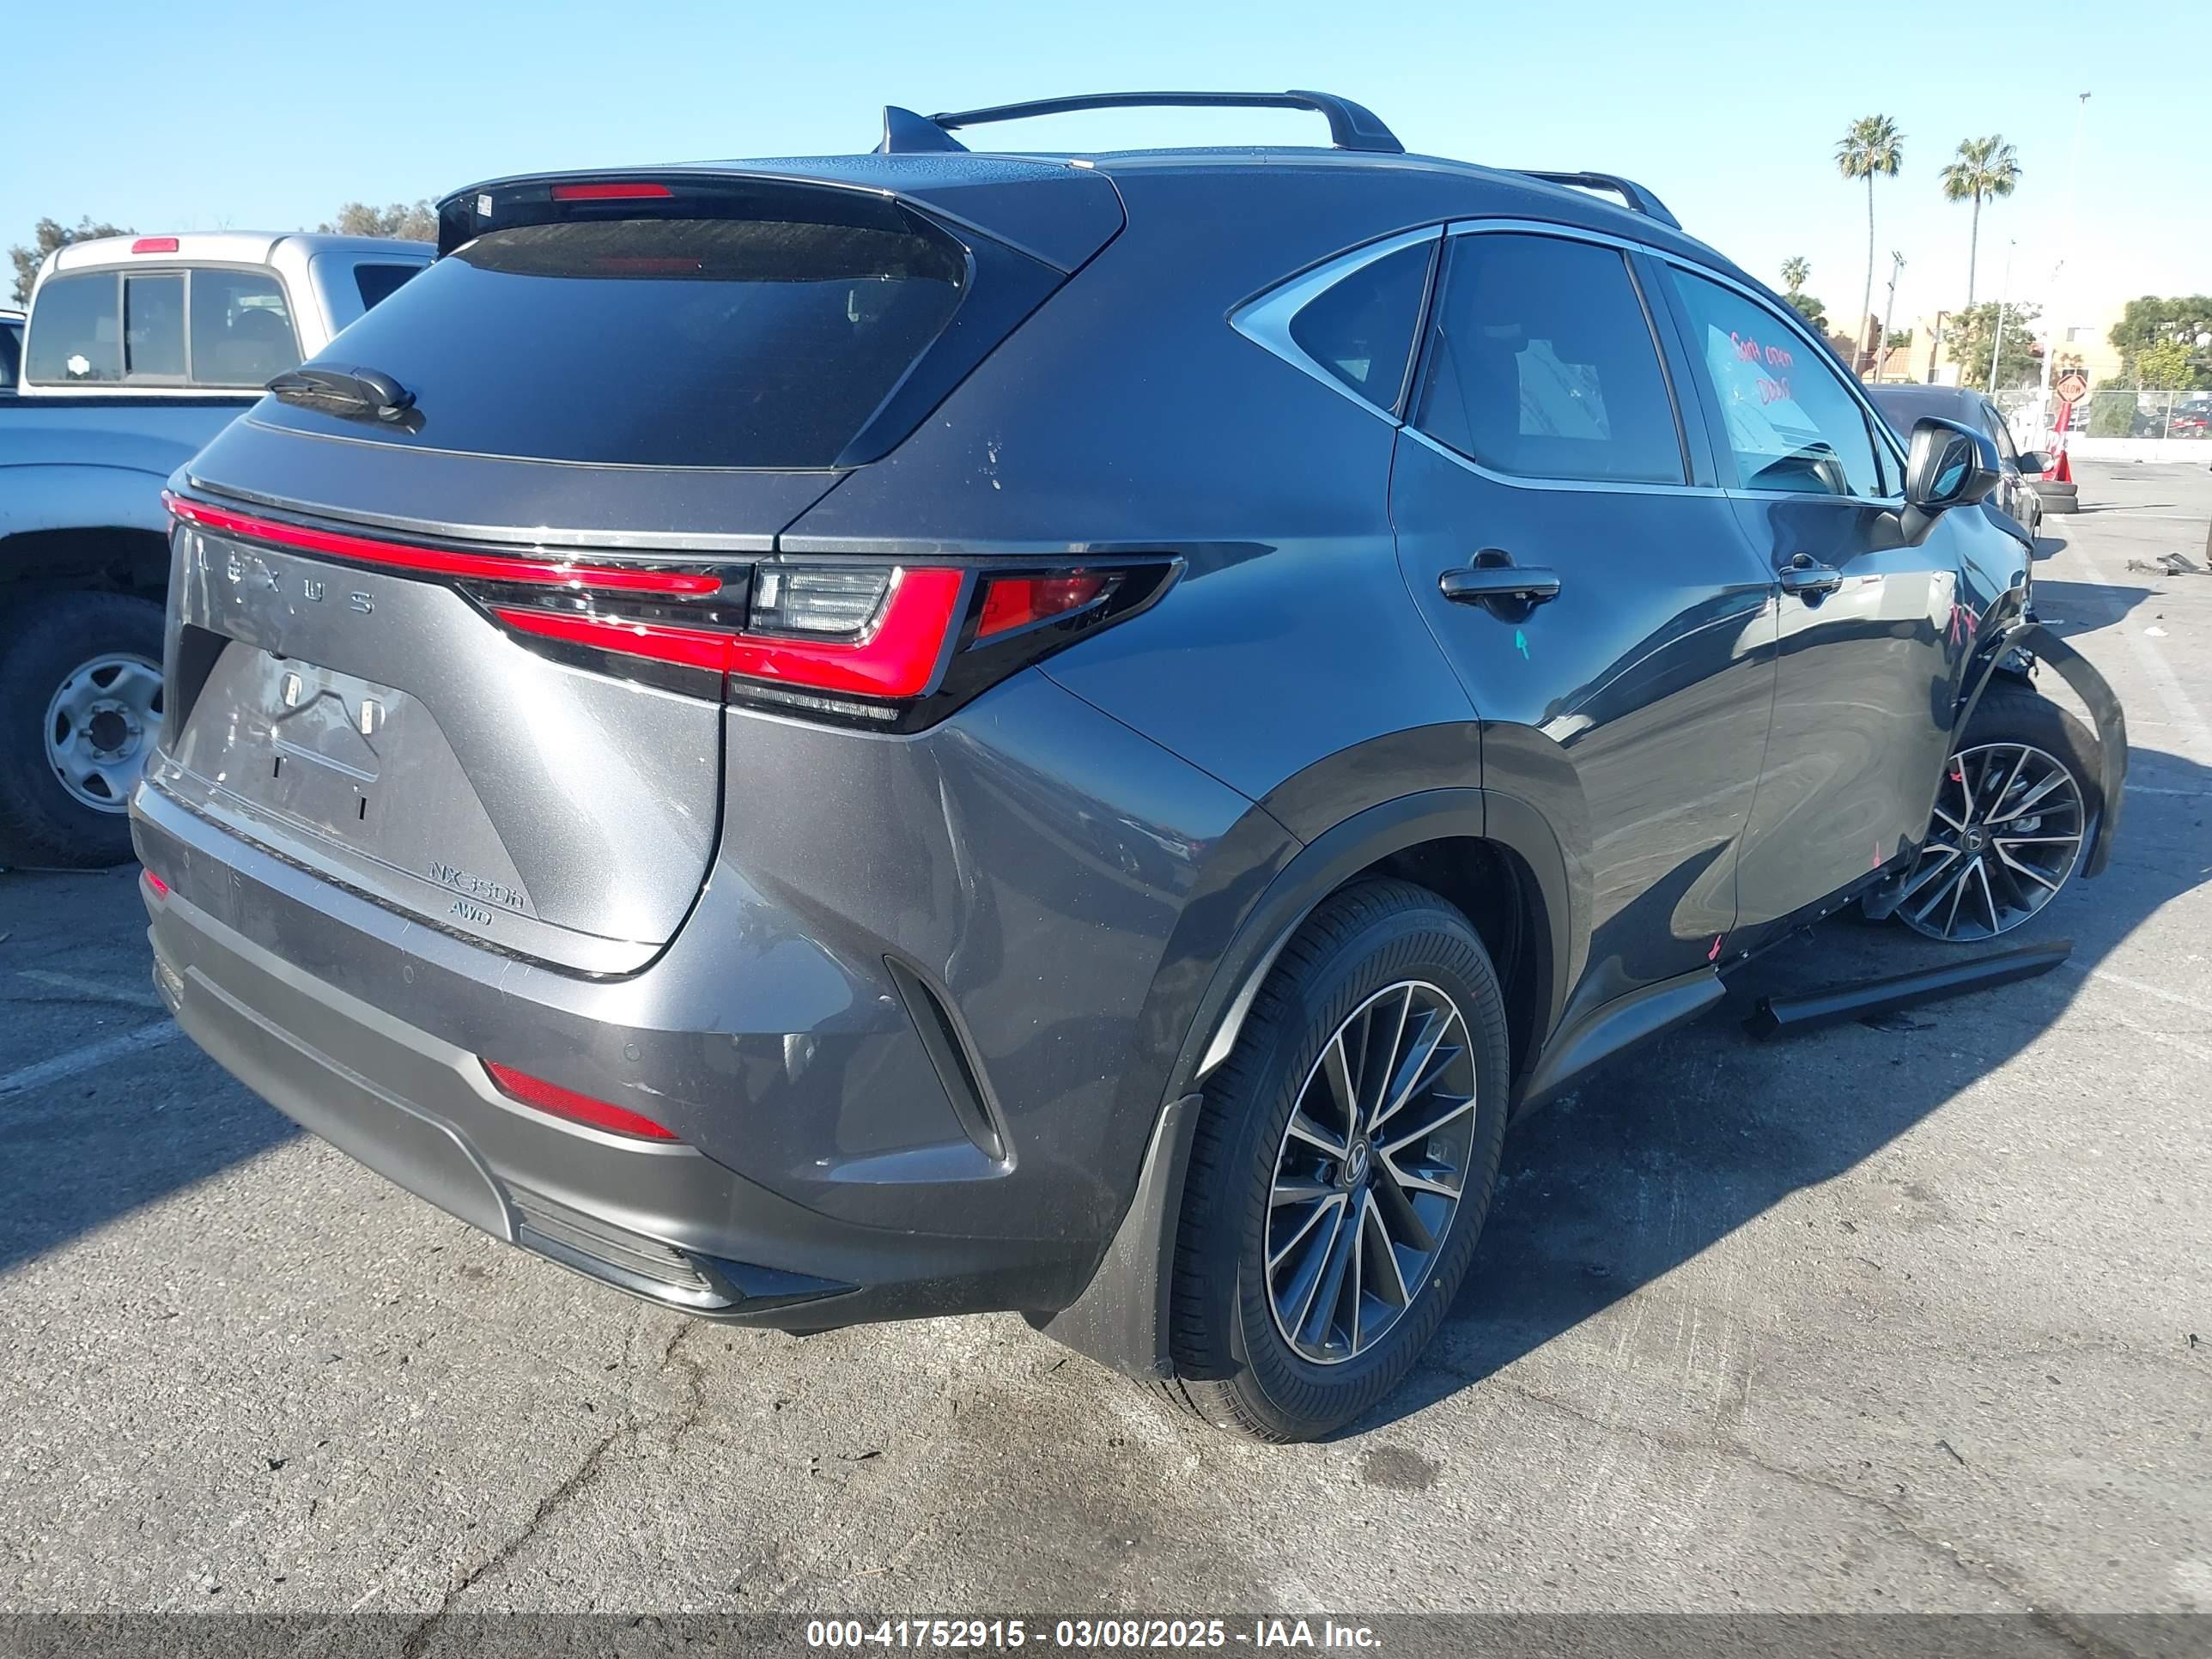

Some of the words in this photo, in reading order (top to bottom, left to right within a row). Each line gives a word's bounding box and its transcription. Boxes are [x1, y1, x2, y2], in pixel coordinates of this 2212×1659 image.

[2061, 383, 2081, 394] SLOW
[197, 538, 376, 615] LEXUS
[448, 901, 493, 927] AWD
